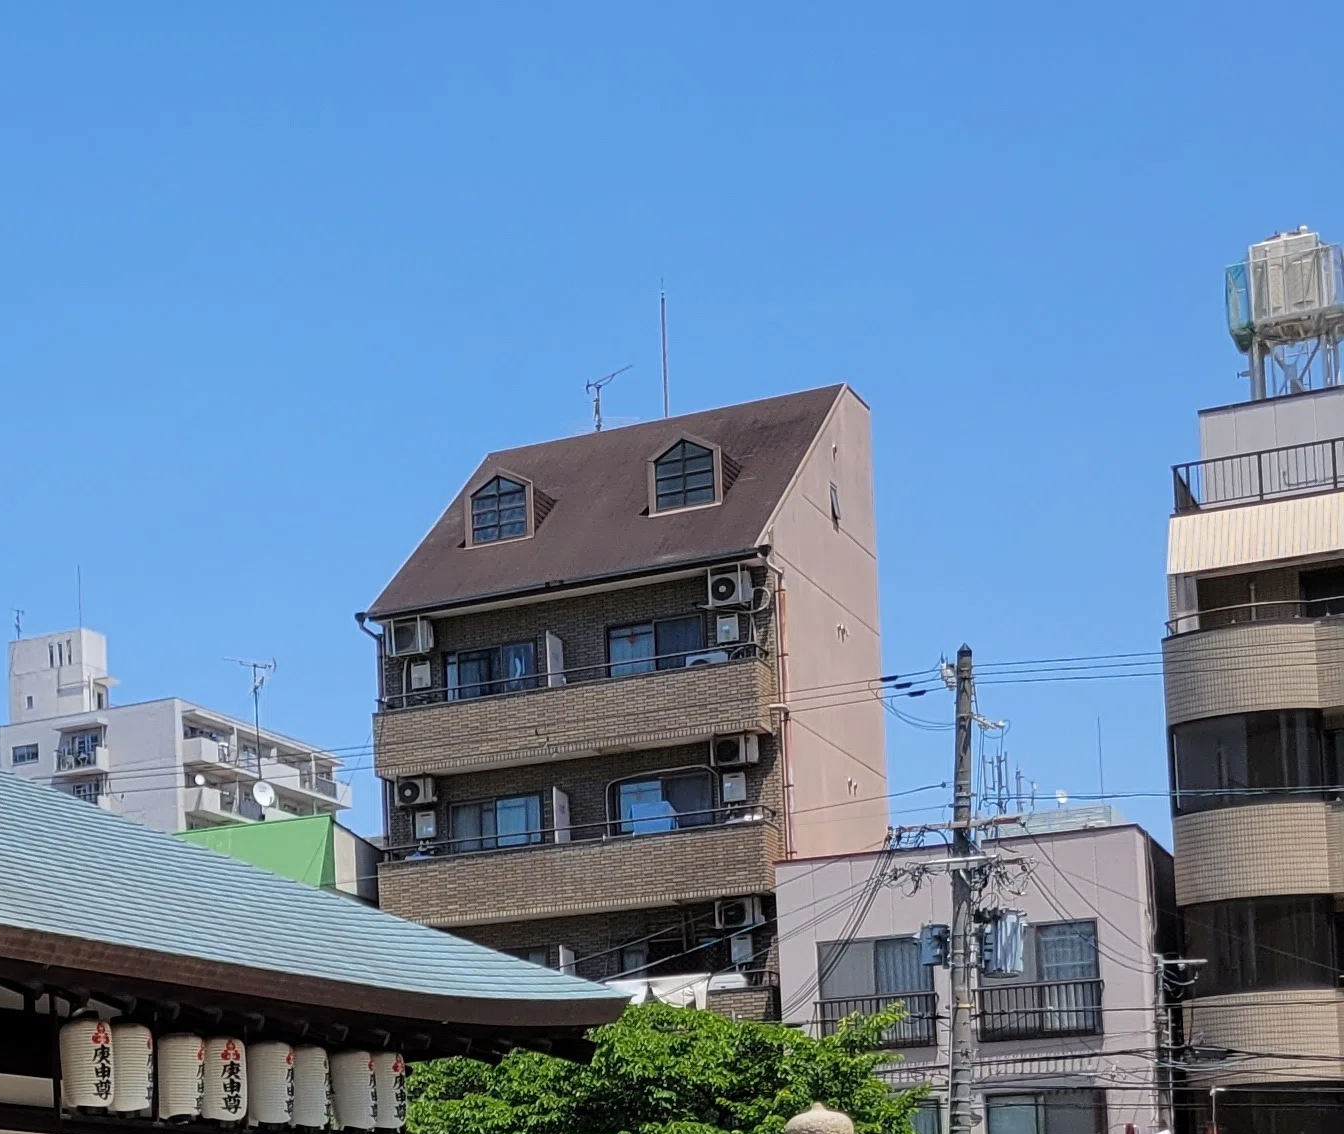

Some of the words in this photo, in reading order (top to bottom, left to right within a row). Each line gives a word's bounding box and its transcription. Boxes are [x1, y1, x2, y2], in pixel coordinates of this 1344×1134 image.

[92, 1045, 112, 1101] 庚申尊
[220, 1061, 242, 1114] 庚申尊
[393, 1074, 407, 1120] 庚申尊
